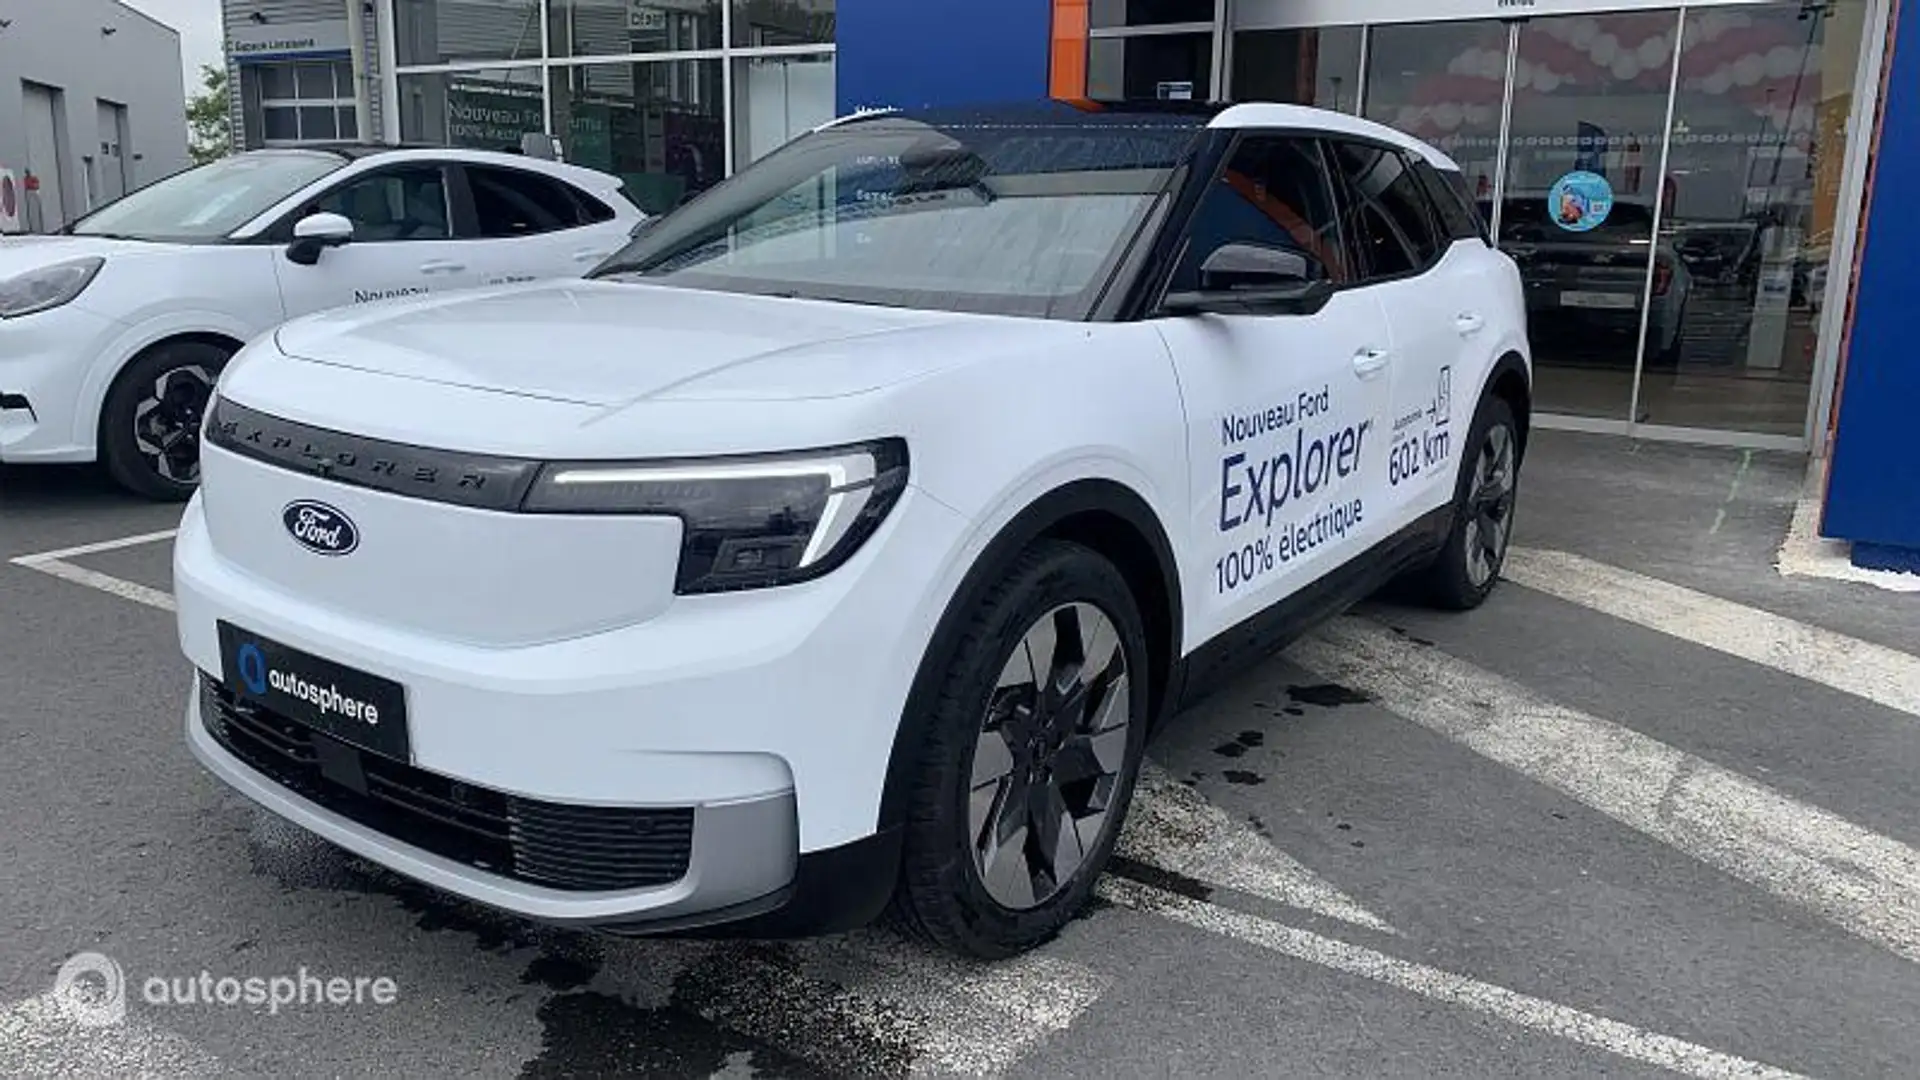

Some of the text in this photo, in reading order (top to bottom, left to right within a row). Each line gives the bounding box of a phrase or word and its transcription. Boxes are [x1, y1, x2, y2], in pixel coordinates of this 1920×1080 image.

[1222, 384, 1329, 446] Nouveau Ford
[217, 421, 487, 490] EXPLORER
[1219, 418, 1369, 532] Explorer
[1390, 436, 1420, 486] 602
[1423, 430, 1450, 467] km
[294, 506, 342, 550] Ford
[1216, 498, 1362, 594] 100% électrique
[268, 668, 378, 725] autosphere
